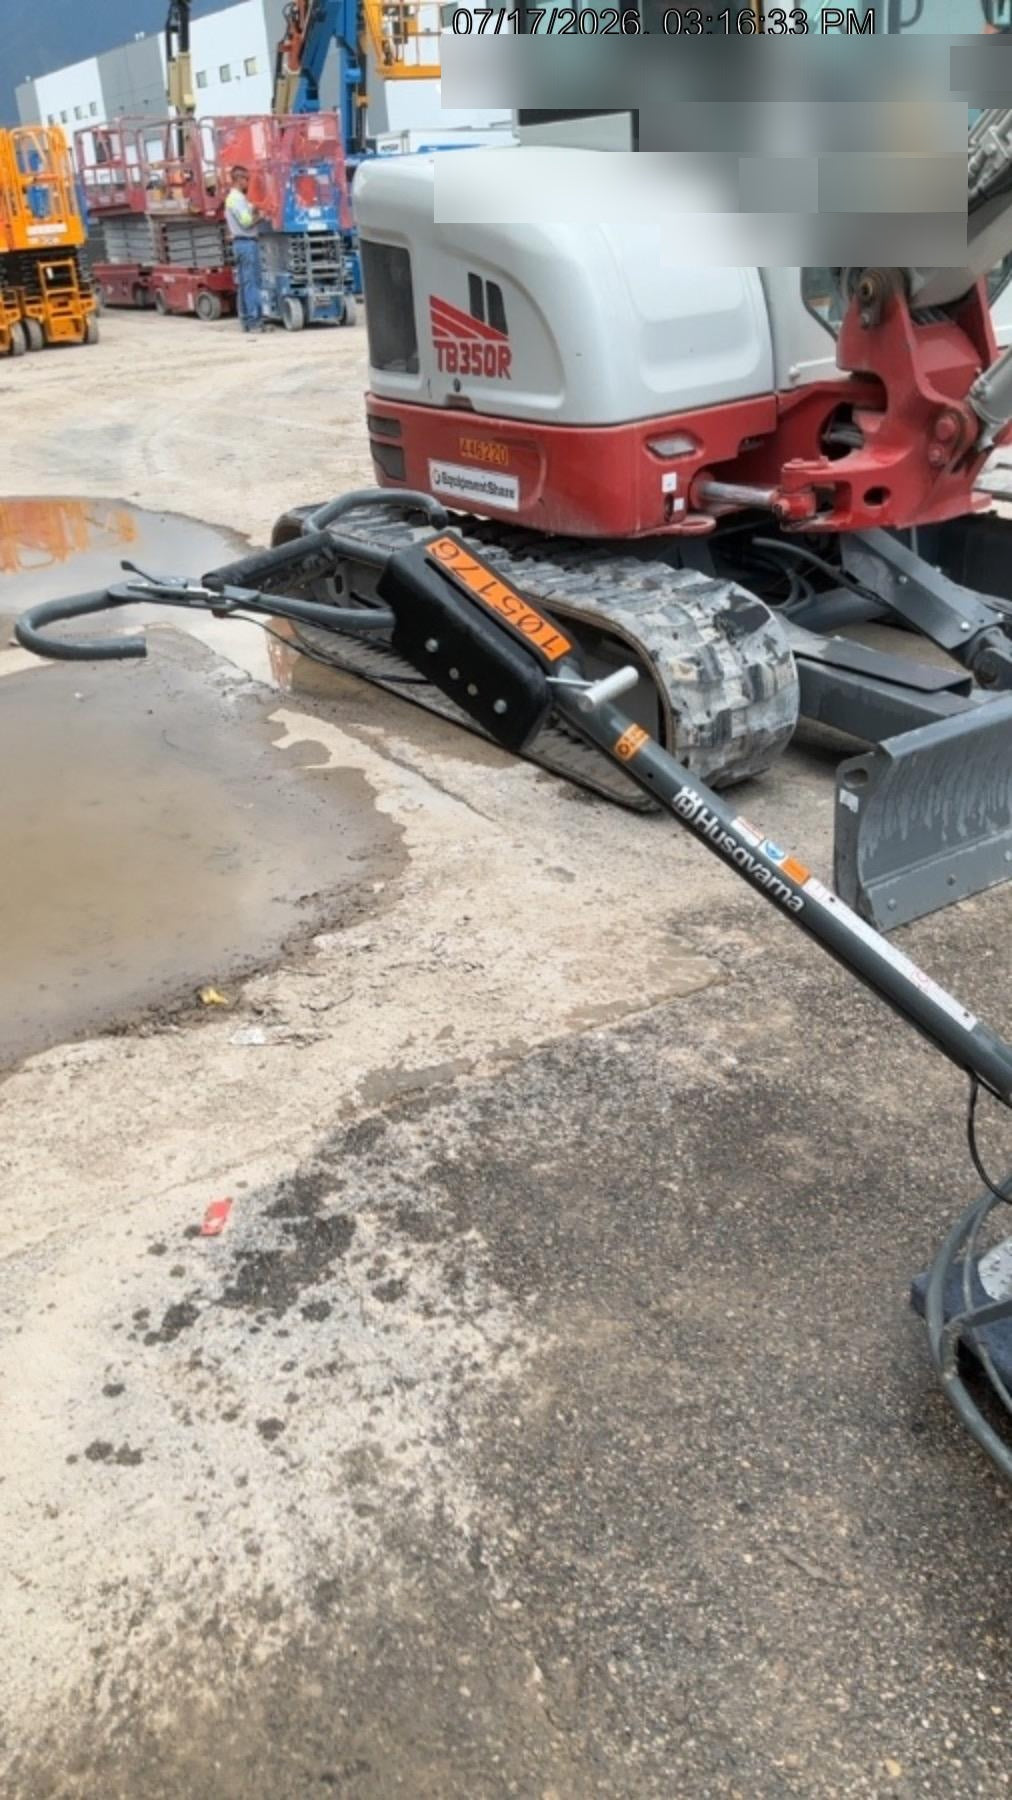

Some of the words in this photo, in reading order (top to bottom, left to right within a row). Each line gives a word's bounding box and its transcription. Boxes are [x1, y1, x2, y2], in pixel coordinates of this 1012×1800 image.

[433, 340, 512, 380] TB350R
[441, 471, 515, 499] EquipmentShare
[432, 541, 560, 652] 105176
[693, 807, 805, 912] Husqvarna
